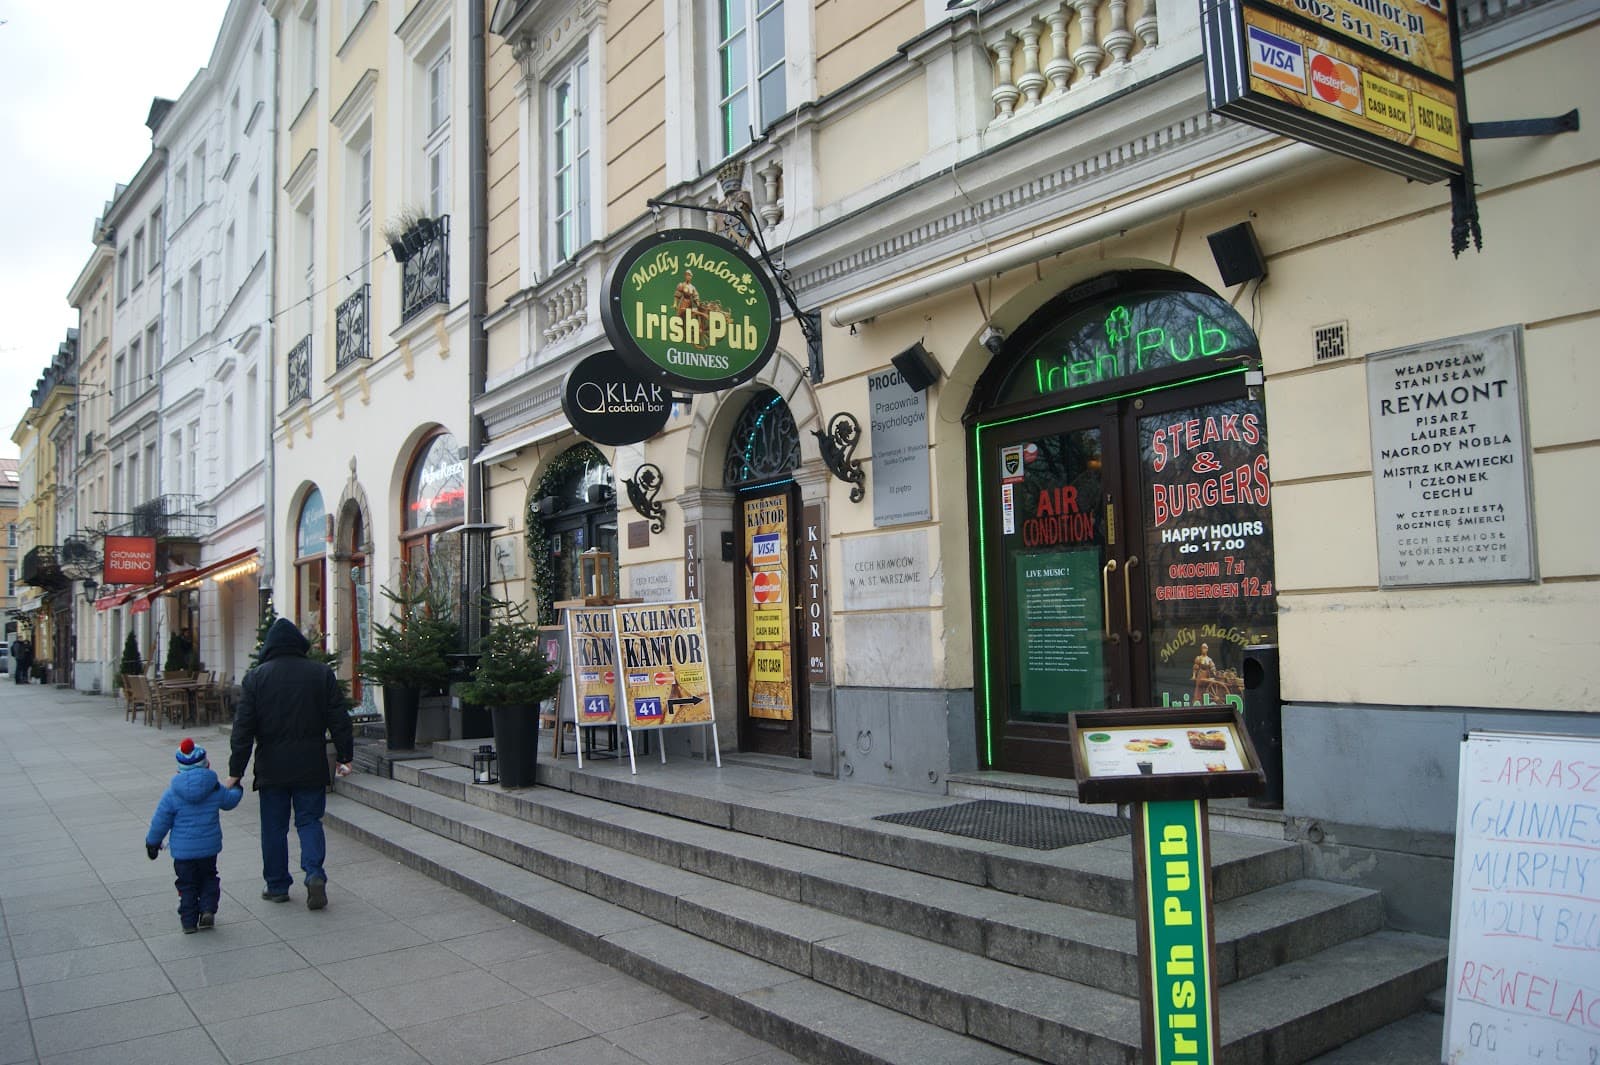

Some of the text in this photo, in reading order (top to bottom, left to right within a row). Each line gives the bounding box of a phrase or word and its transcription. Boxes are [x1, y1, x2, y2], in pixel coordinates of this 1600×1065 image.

[1342, 10, 1373, 39] 511
[1380, 30, 1409, 57] 511
[1260, 44, 1294, 72] VISA
[1313, 70, 1358, 97] MasterCard
[1368, 97, 1407, 124] CASH BACK
[1418, 104, 1454, 137] FAST CASH
[631, 251, 757, 306] Molly Malone's
[635, 301, 758, 351] Irish Pub
[666, 348, 729, 369] GUINNESS
[1036, 315, 1227, 393] Irish Pub
[1395, 353, 1485, 376] WŁADYSŁAW
[1395, 366, 1486, 390] STANISŁAW
[608, 402, 664, 413] cocktail bar
[875, 396, 919, 415] Pracownia
[1381, 379, 1508, 416] REYMONT
[871, 411, 926, 432] Psychologów
[1416, 411, 1469, 427] PISARZ
[1153, 413, 1259, 472] STEAKS
[1411, 424, 1477, 441] LAUREAT
[1381, 434, 1511, 460] NAGRODY NOBLA
[1192, 451, 1222, 473] &
[1383, 454, 1513, 478] MISTRZ KRAWIECKI
[1153, 453, 1270, 527] BURGERS
[1408, 472, 1488, 488] I CZŁONEK
[1036, 485, 1079, 518] AIR
[1422, 487, 1473, 500] CECHU
[747, 498, 783, 512] EXCHANGE
[1396, 503, 1504, 520] W CZTERDZIESTĄ
[747, 509, 784, 527] KANTOR
[1023, 511, 1095, 547] CONDITION
[1396, 514, 1505, 531] ROCZNICĘ ŚMIERCI
[1162, 521, 1263, 543] HAPPY HOURS
[1398, 537, 1429, 546] CECH
[758, 542, 775, 555] VISA
[1179, 539, 1245, 553] do 17.00
[110, 559, 151, 570] RUBINO
[1169, 561, 1219, 578] OKOCIM
[1224, 556, 1234, 575] 7
[1399, 554, 1507, 568] W WARSZAWIE
[808, 525, 821, 637] KANTOR
[1025, 569, 1042, 578] LIVE
[1043, 567, 1065, 577] MUSIC
[1156, 582, 1239, 600] GRIMBERGEN
[1241, 577, 1260, 596] 12
[622, 607, 697, 633] EXCHANGE
[624, 634, 702, 668] KANTOR
[1160, 627, 1196, 663] Molly
[757, 658, 768, 673] FAST
[588, 699, 606, 713] 41
[639, 702, 657, 716] 41
[1480, 756, 1600, 792] APRASZ
[1160, 824, 1193, 927] Pub
